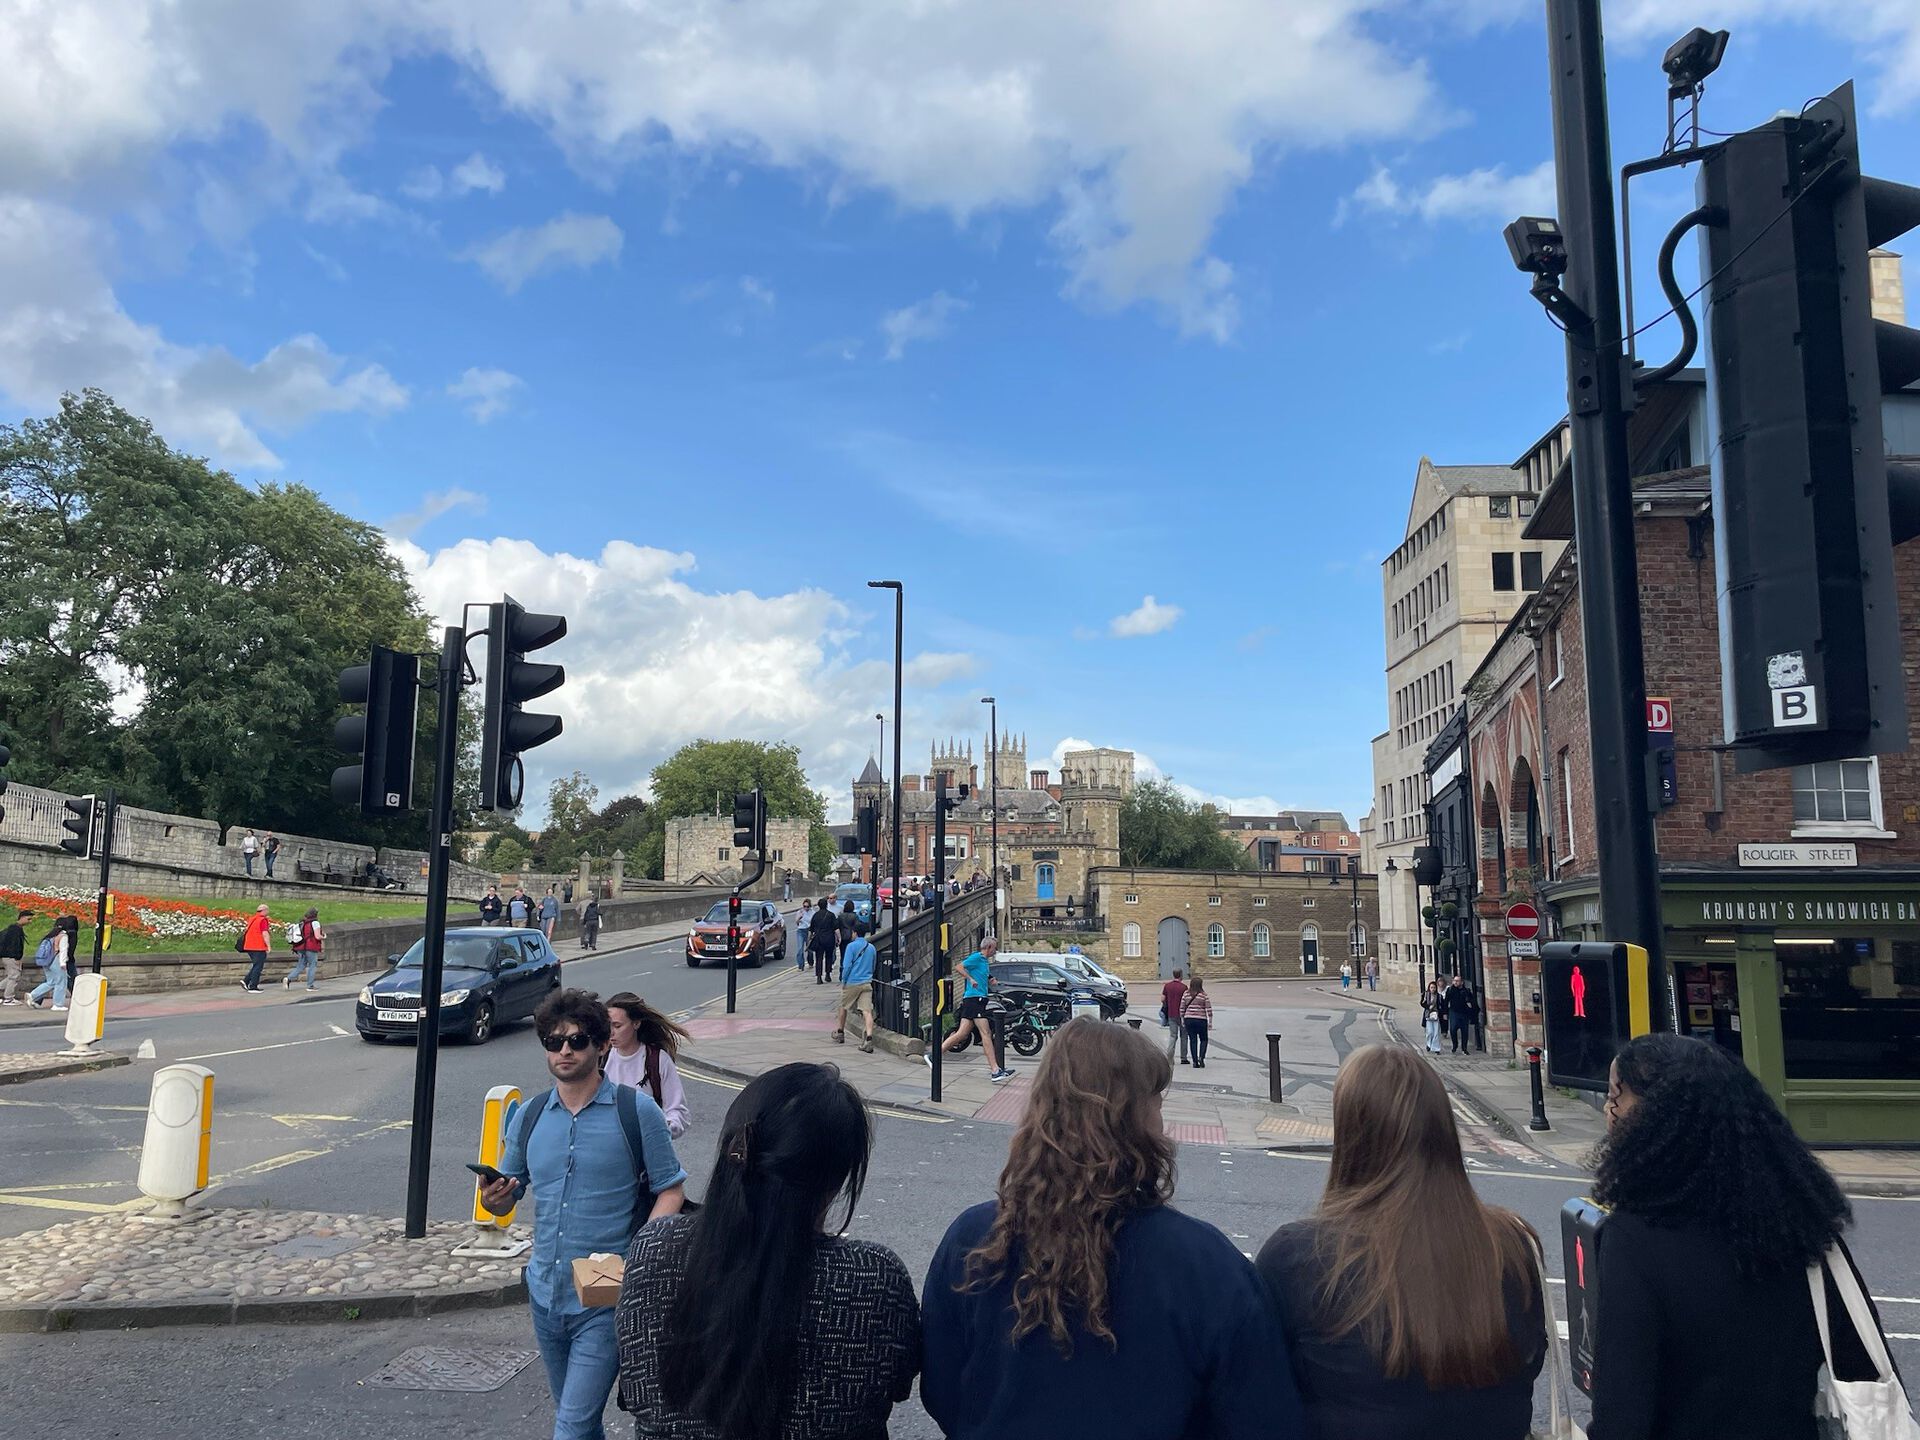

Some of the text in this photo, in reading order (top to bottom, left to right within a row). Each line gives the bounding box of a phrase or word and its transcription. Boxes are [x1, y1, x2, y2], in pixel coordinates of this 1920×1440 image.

[1780, 691, 1808, 720] B
[389, 795, 399, 805] C
[1743, 849, 1852, 861] ROUGIER STREET
[1703, 901, 1920, 920] KRUNCHY'S SANDWICH BA
